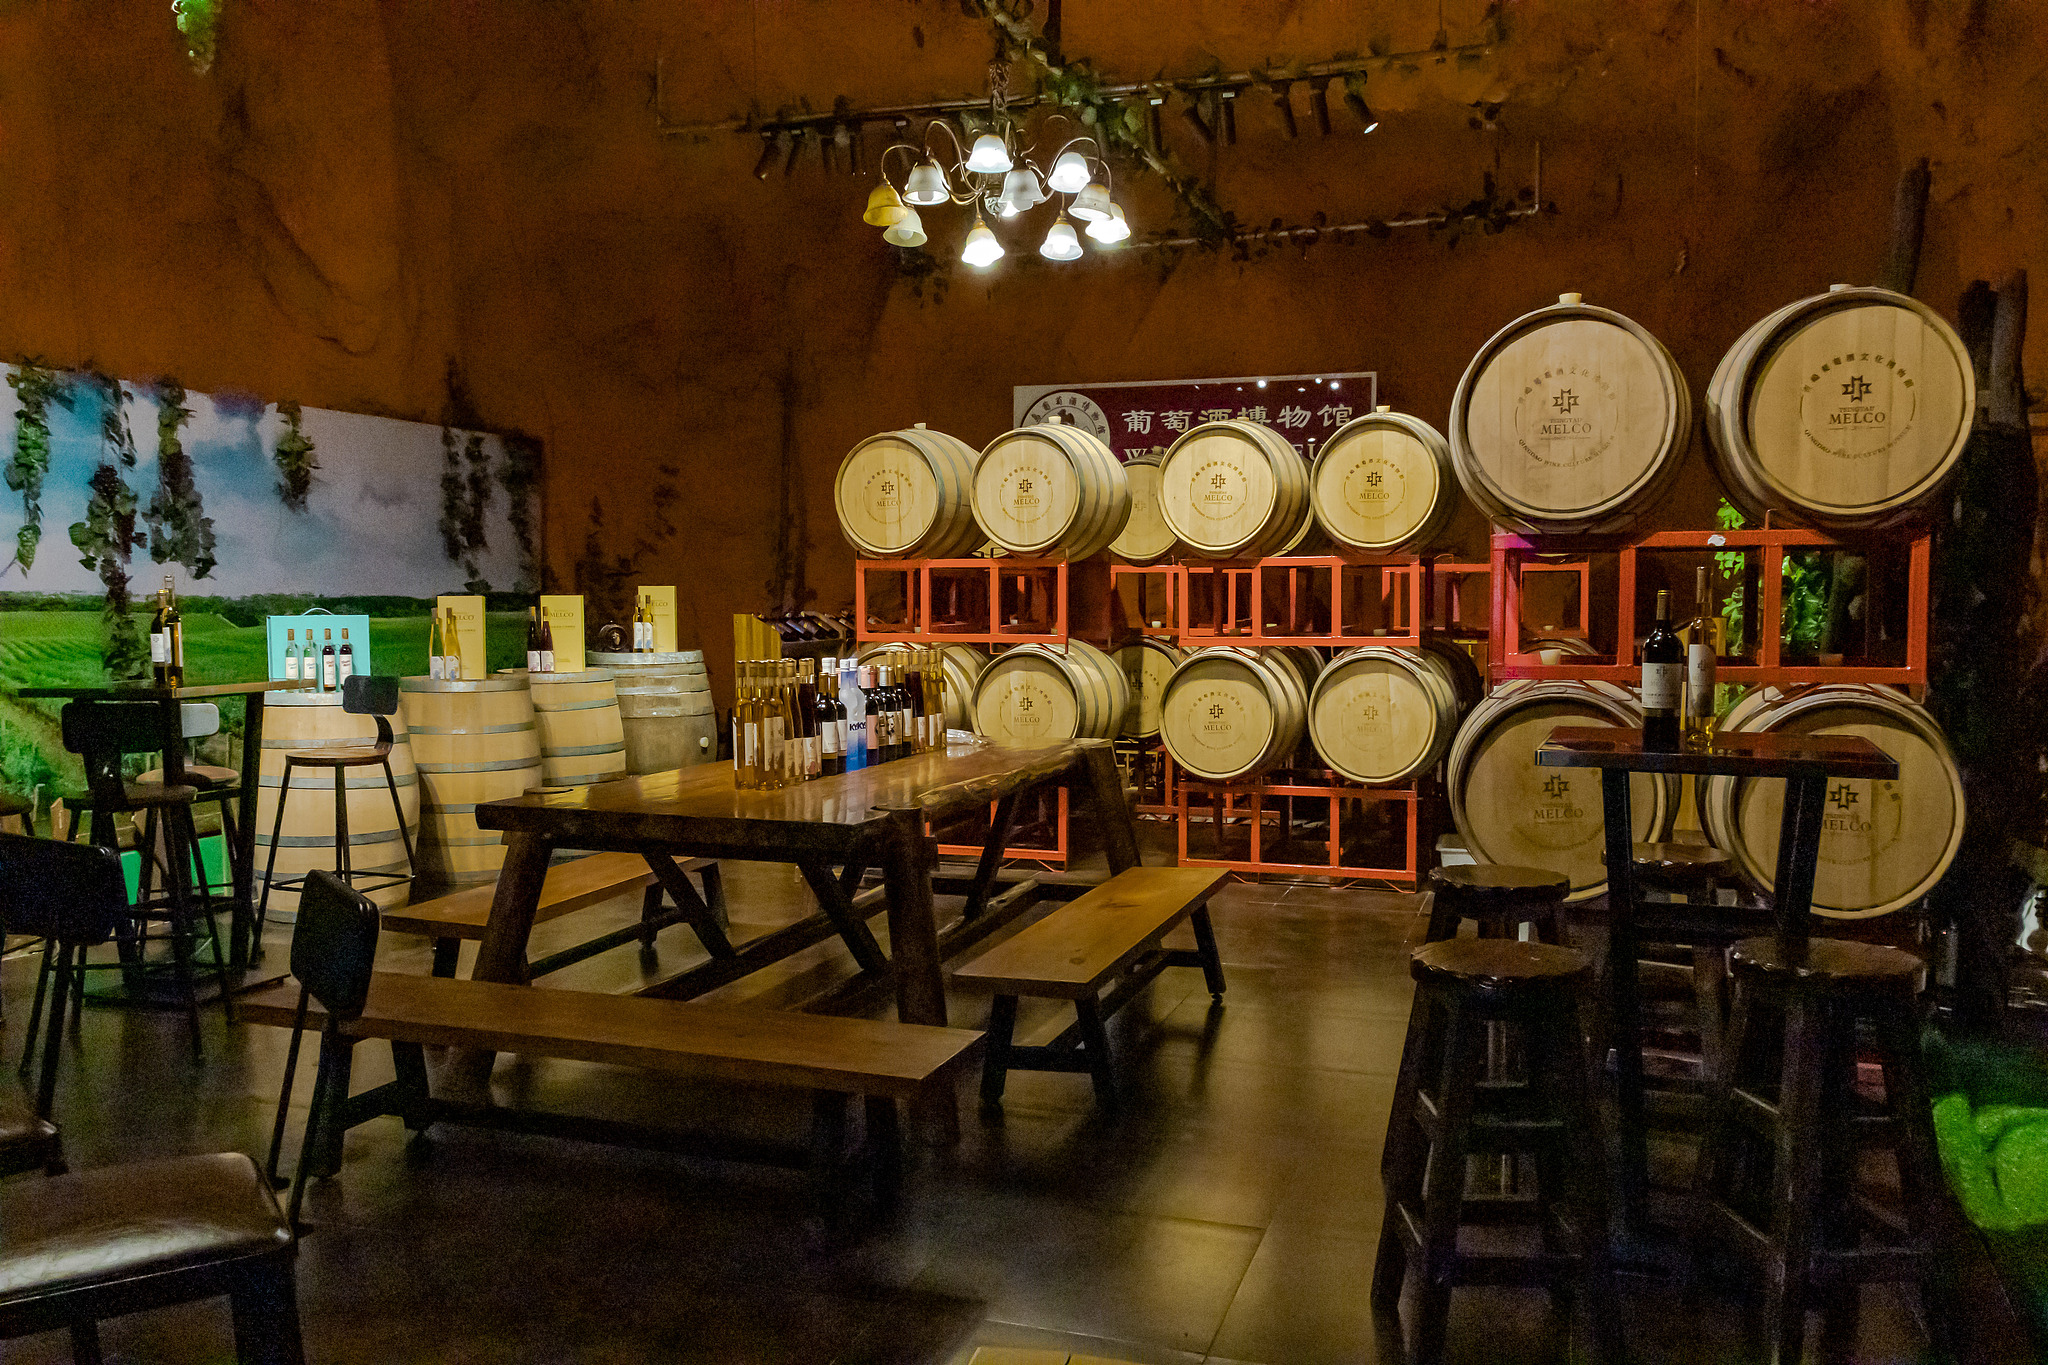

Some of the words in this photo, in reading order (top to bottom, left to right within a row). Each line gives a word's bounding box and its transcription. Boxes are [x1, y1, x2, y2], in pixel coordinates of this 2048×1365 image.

[1121, 403, 1353, 435] 葡萄酒博物馆
[1829, 411, 1886, 425] MELCO
[1540, 423, 1592, 435] MELCO
[1204, 494, 1233, 502] MELCO
[1359, 492, 1390, 500] MELCO
[876, 499, 902, 507] MELCO
[1013, 497, 1040, 506] MELCO
[1203, 724, 1232, 732] MELCO
[1534, 807, 1584, 820] MELCO
